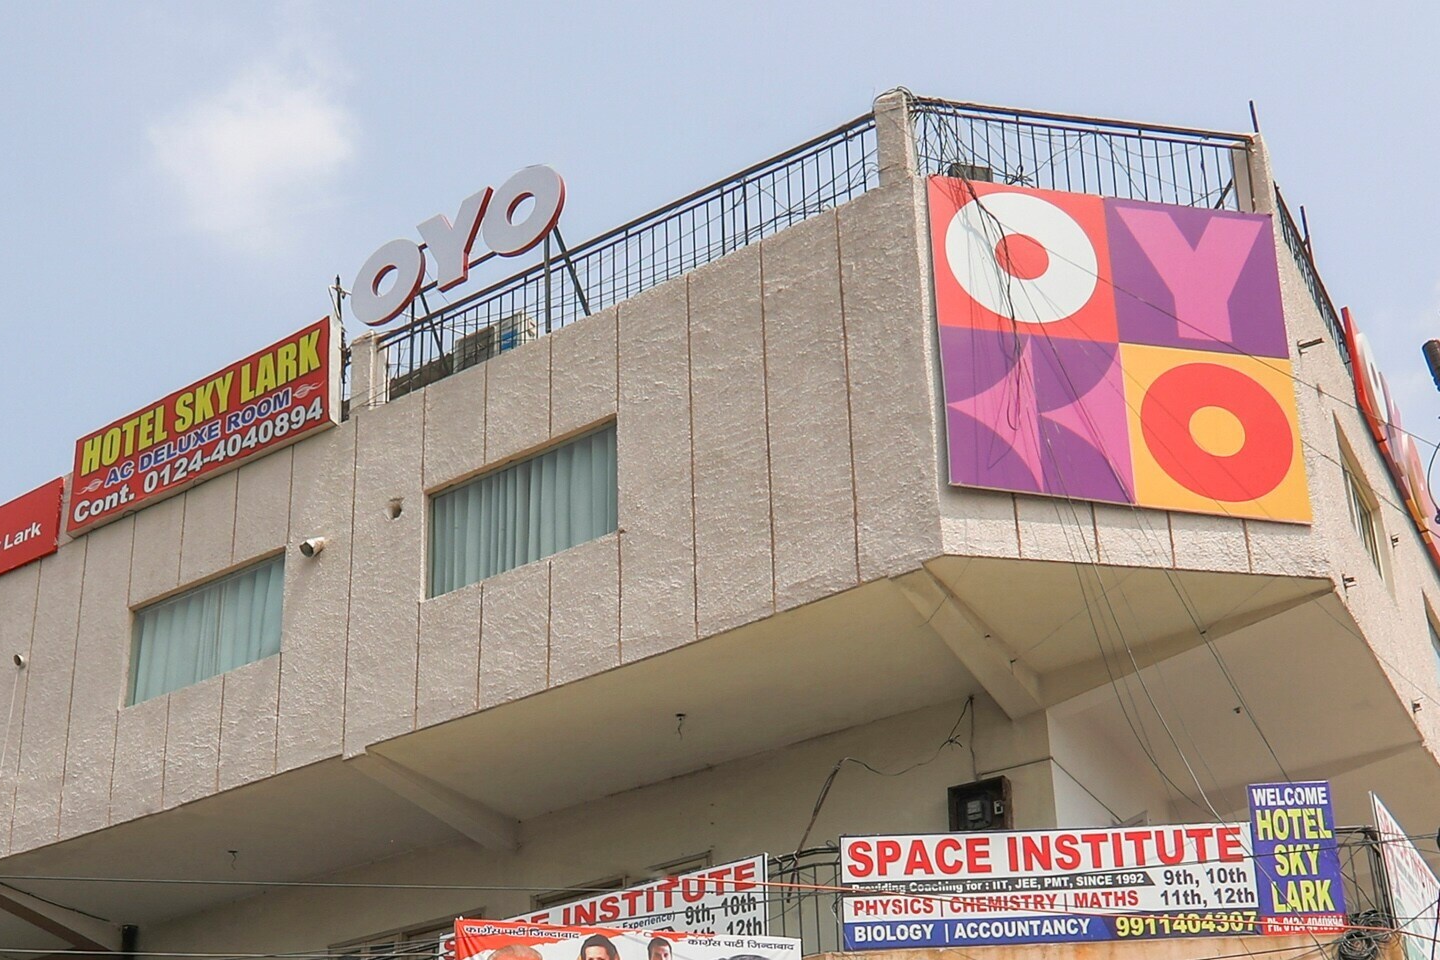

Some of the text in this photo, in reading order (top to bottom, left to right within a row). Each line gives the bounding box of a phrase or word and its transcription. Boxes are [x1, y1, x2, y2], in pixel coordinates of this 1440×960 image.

[351, 164, 566, 326] OYO
[80, 328, 324, 477] HOTEL SKY LARK
[104, 388, 293, 487] AC DELUXE ROOM
[73, 397, 324, 523] Cont. 0124-4040894
[3, 522, 42, 551] Lark
[1252, 787, 1328, 806] WELCOME
[1255, 808, 1332, 840] HOTEL
[847, 826, 1244, 878] SPACE INSTITUTE
[1273, 844, 1320, 876] SKY
[562, 862, 756, 926] INSTITUTE
[852, 873, 1144, 894] Providing Coaching for IIT, JEE, PMT, SINCE 1992
[1163, 868, 1247, 888] 9th, 10th
[685, 892, 757, 925] 9th, 10th
[854, 890, 1139, 916] PHYSICS CHEMISTRY MATHS
[1160, 888, 1255, 907] 11th, 12th
[1271, 880, 1335, 913] LARK
[727, 917, 762, 936] 12th
[854, 924, 934, 942] BIOLOGY
[954, 918, 1090, 938] ACCOUNTANCY
